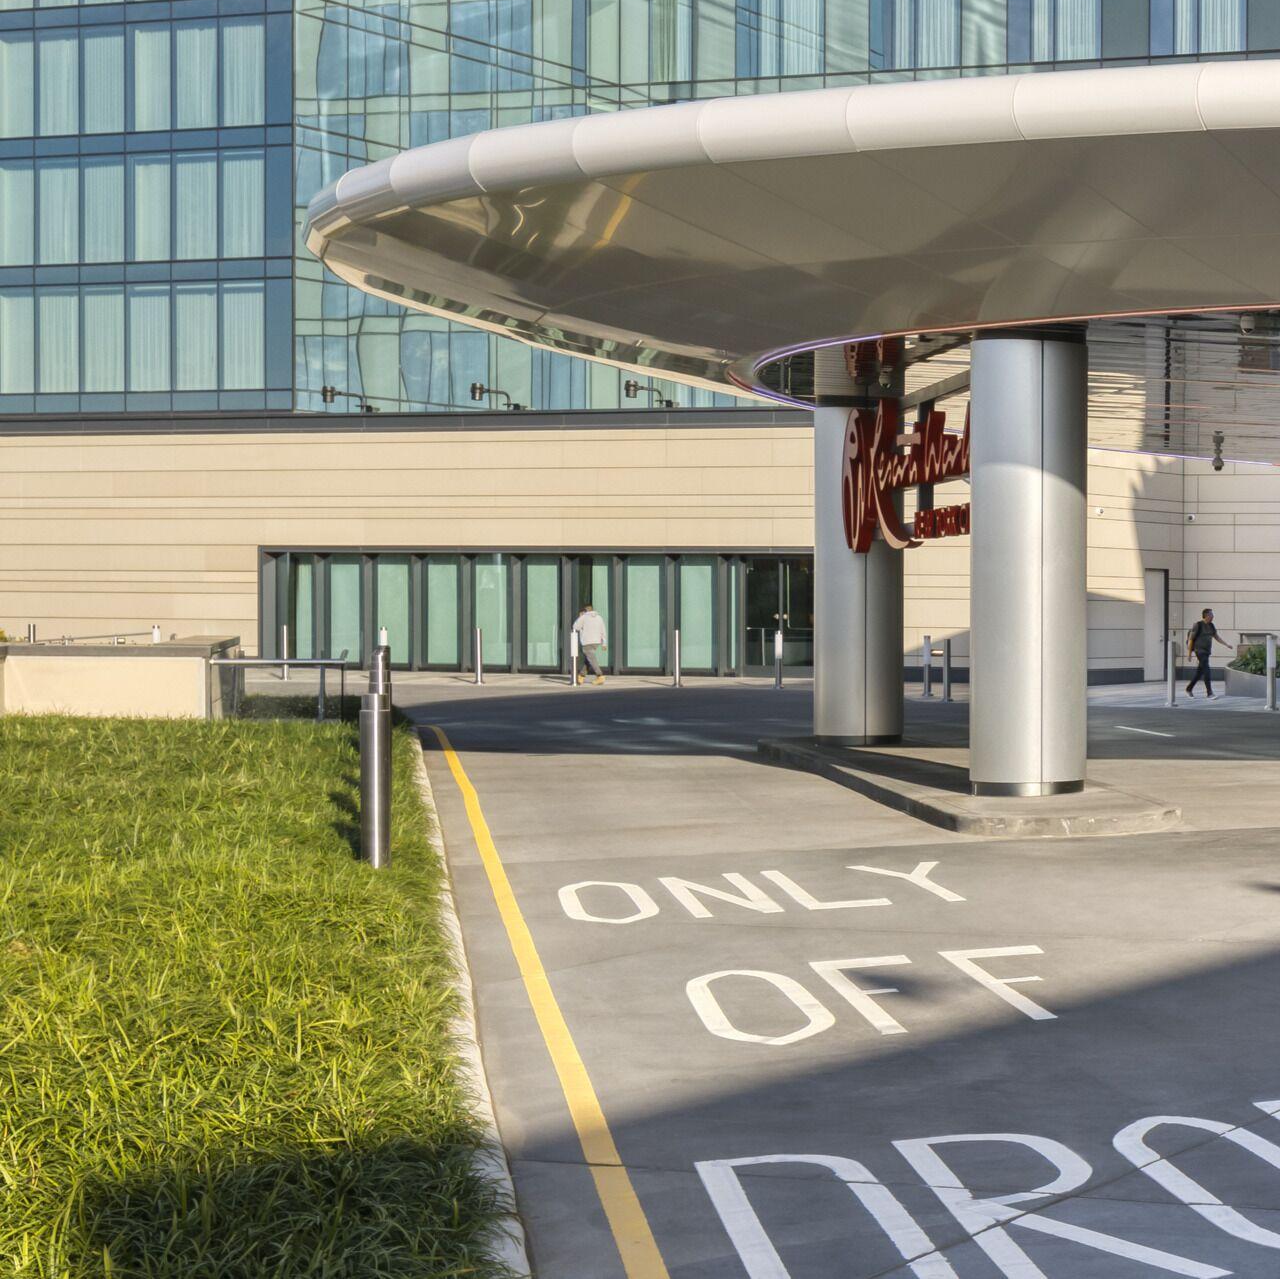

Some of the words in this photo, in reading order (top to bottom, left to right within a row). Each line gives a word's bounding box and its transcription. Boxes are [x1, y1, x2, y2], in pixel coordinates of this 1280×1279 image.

[924, 401, 970, 481] Worl
[556, 860, 968, 925] ONLY
[685, 944, 1059, 1047] OFF
